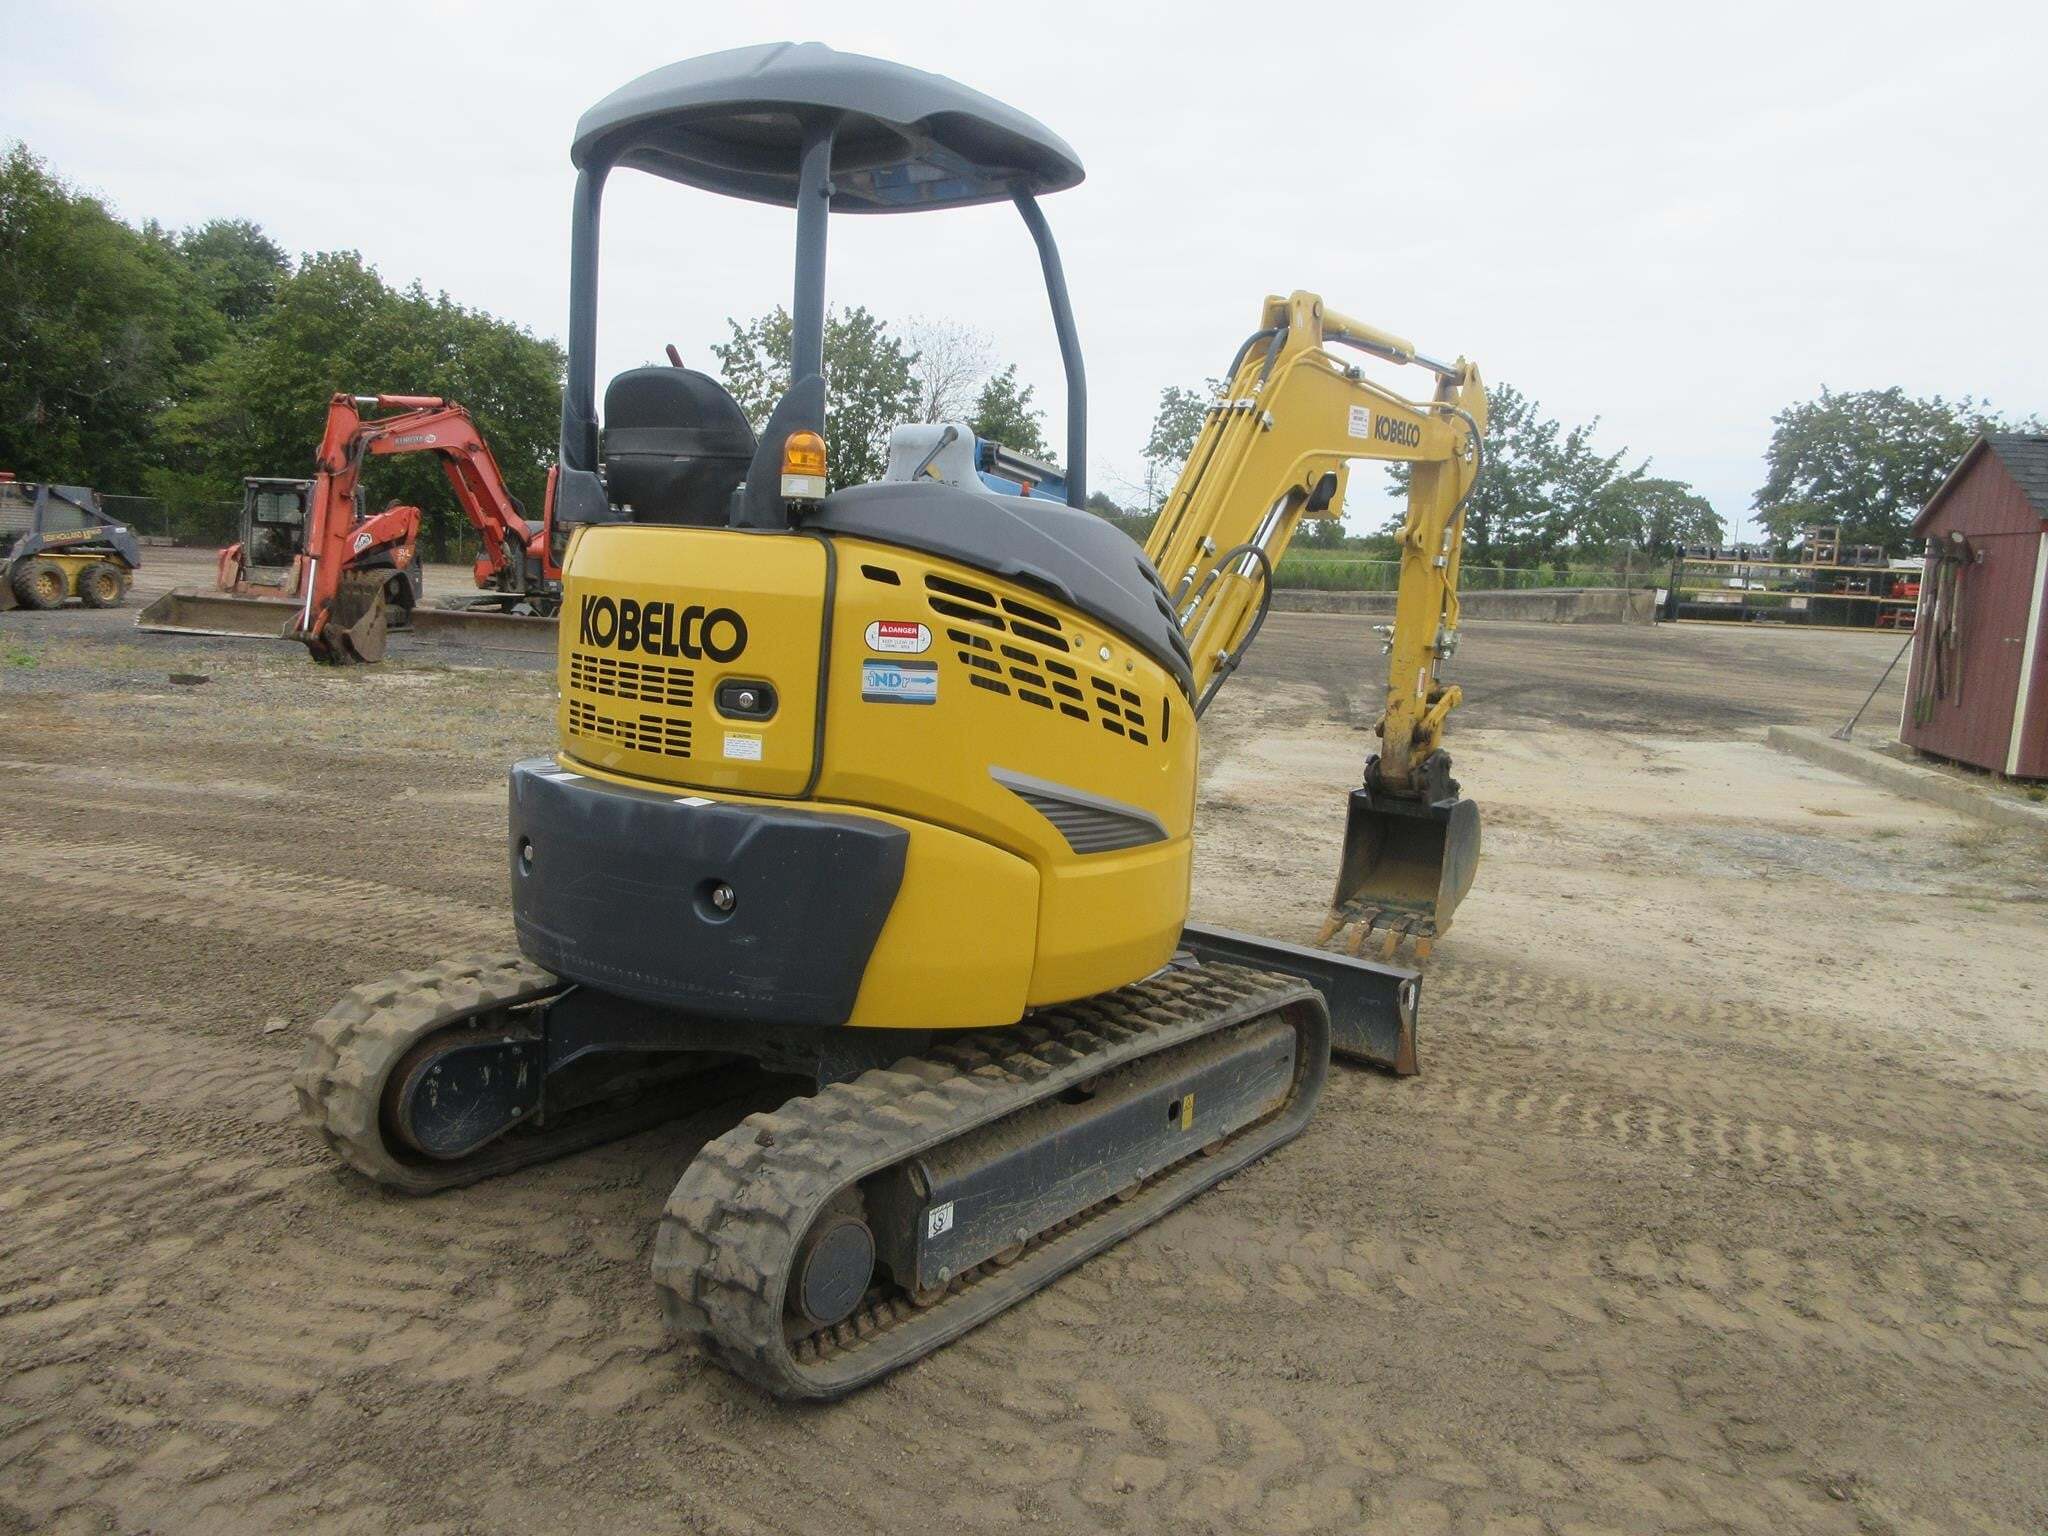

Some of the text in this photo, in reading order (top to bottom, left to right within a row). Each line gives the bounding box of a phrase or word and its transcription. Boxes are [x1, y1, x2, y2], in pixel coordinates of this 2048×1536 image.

[1375, 415, 1420, 448] KOBELCO
[580, 594, 748, 663] KOBELCO
[888, 626, 917, 634] DANGER
